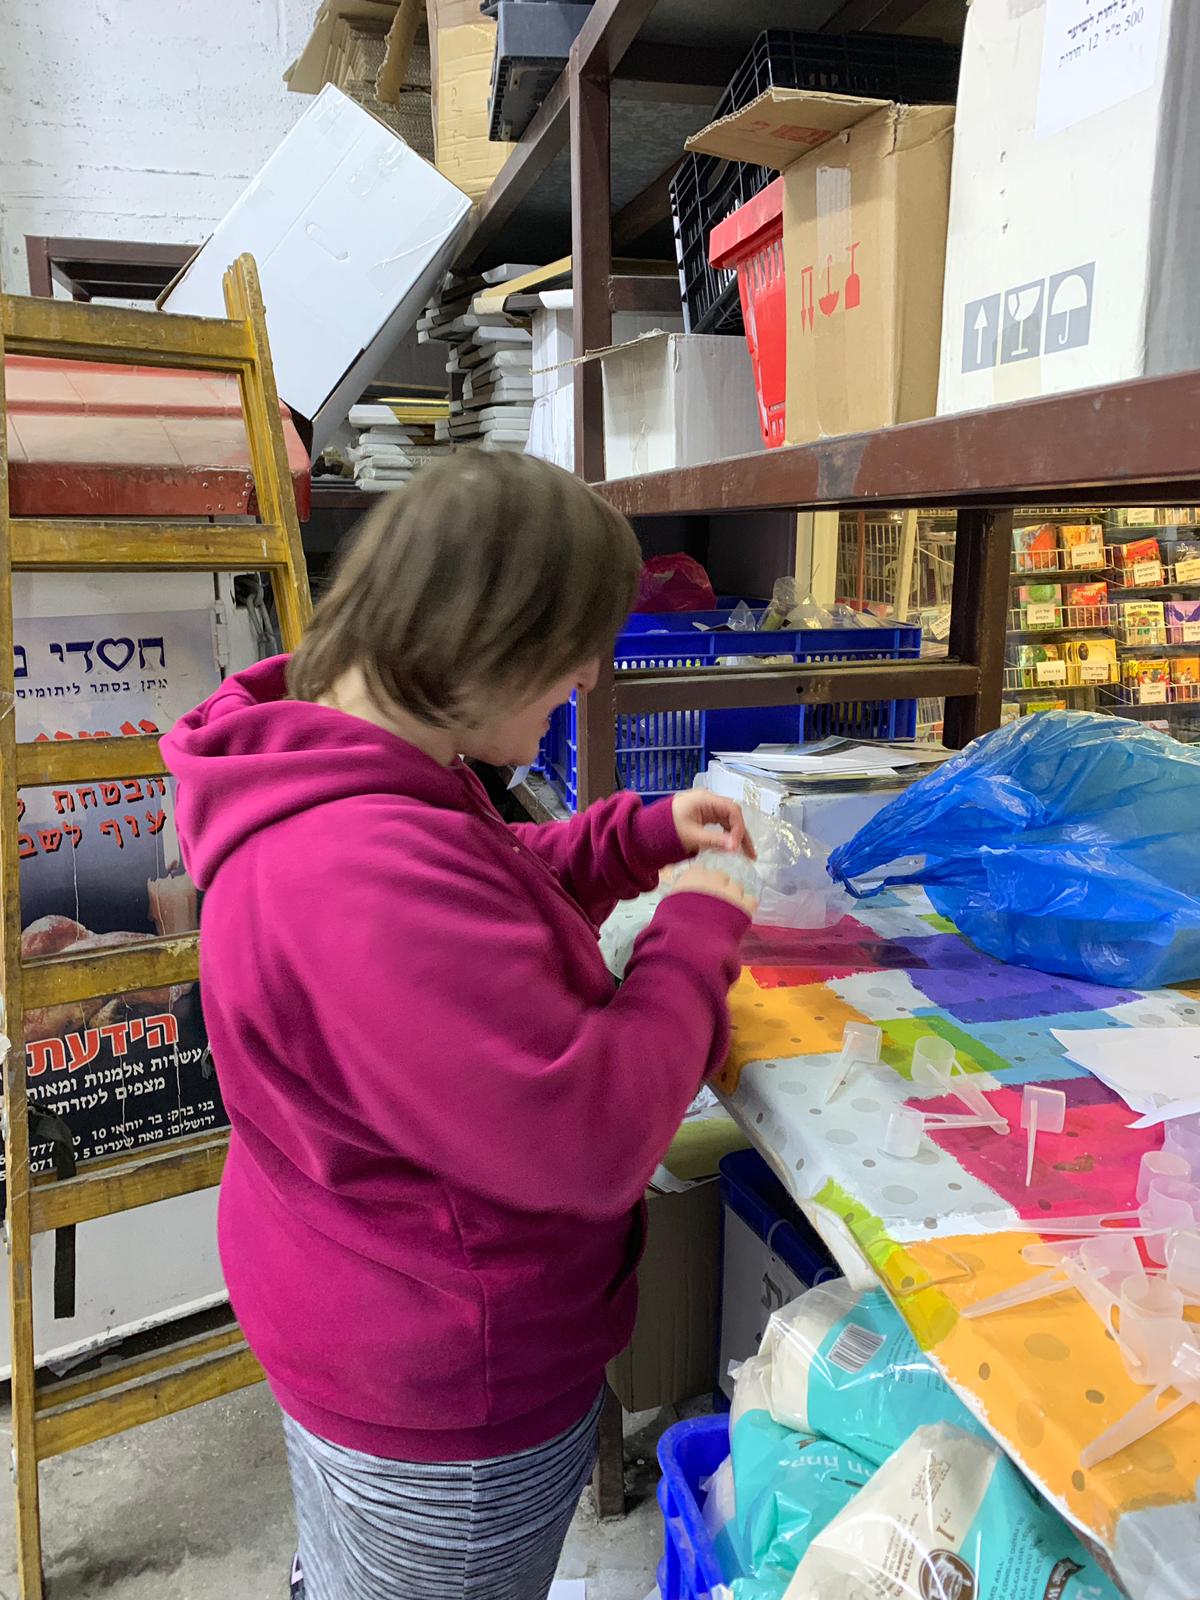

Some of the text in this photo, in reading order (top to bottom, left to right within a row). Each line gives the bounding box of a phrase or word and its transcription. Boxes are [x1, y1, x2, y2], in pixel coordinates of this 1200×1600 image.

[1124, 7, 1145, 31] 500
[1088, 33, 1099, 51] 12
[16, 683, 81, 699] ליתומים
[90, 680, 131, 694] בסתר
[18, 821, 83, 859] לשב
[26, 1013, 180, 1077] הידעת
[26, 1048, 202, 1101] עשרות אלמנות ומאות
[114, 1076, 166, 1100] מצפים
[198, 1100, 215, 1112] בני
[110, 1119, 144, 1135] יוחאי
[148, 1113, 163, 1125] בר
[91, 1128, 107, 1140] 10
[138, 1129, 164, 1143] מאה
[83, 1146, 91, 1159] 5
[95, 1136, 135, 1155] שערים
